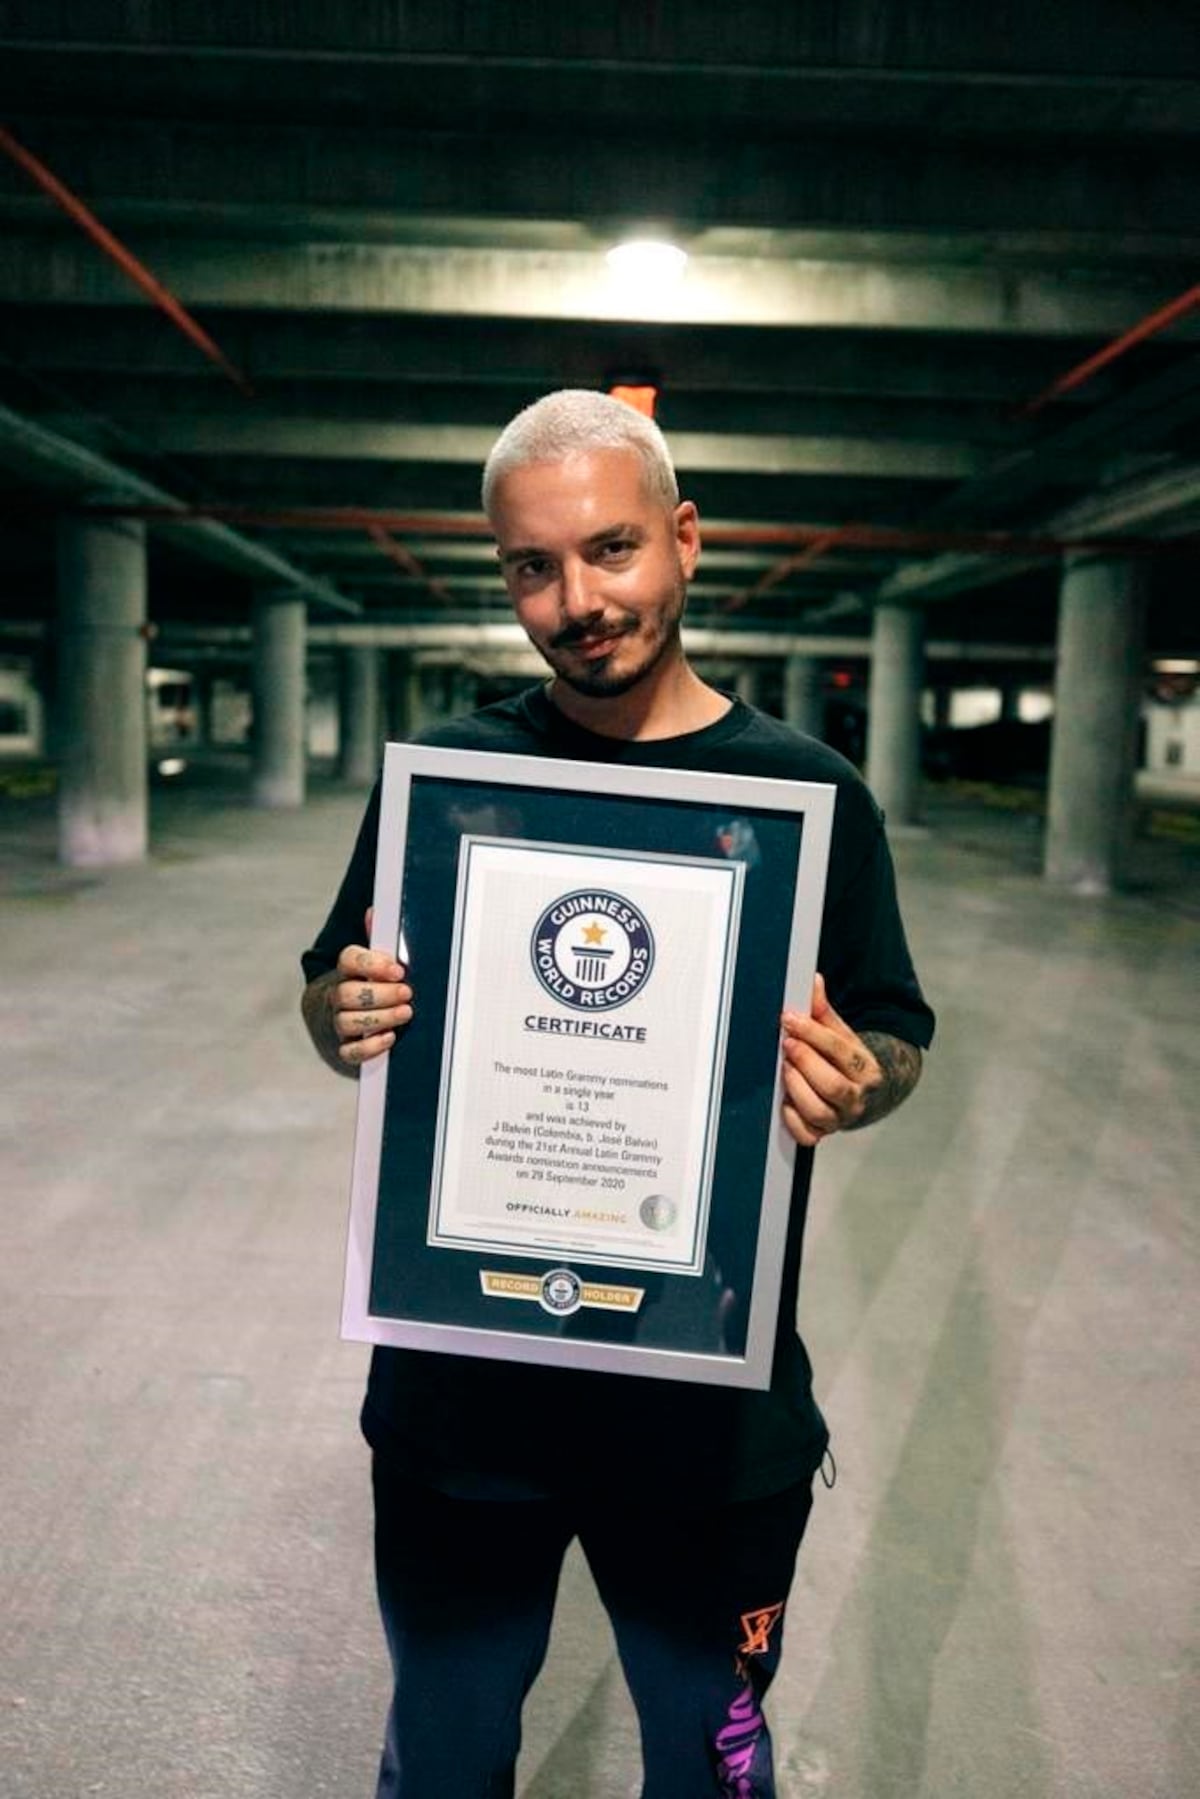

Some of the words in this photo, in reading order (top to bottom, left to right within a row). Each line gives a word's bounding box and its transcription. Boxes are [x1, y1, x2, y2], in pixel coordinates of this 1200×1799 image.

[551, 896, 641, 933] GUINNESS
[538, 938, 575, 998] WORLD
[580, 947, 648, 1005] RECORDS
[524, 1015, 647, 1041] CERTIFICATE
[494, 1061, 511, 1074] The
[513, 1066, 538, 1077] most
[540, 1067, 564, 1079] Latin
[566, 1069, 606, 1086] Grammy
[609, 1078, 669, 1091] nominations
[543, 1084, 552, 1093] in
[554, 1085, 560, 1094] a
[563, 1086, 591, 1098] single
[594, 1090, 614, 1100] year
[565, 1101, 574, 1110] is
[578, 1100, 590, 1112] 13
[492, 1120, 499, 1132] J
[502, 1121, 531, 1136] Balvin
[624, 1136, 658, 1150] Balvin)
[525, 1112, 544, 1122] and
[546, 1115, 566, 1125] was
[568, 1116, 612, 1130] achieved
[614, 1120, 627, 1133] by
[485, 1135, 515, 1150] during
[518, 1139, 533, 1150] the
[535, 1141, 557, 1153] 21st
[560, 1143, 593, 1157] Annual
[595, 1147, 619, 1159] Latin
[621, 1150, 663, 1167] Grammy
[487, 1150, 524, 1163] Awards
[526, 1156, 579, 1169] nomination
[582, 1162, 657, 1179] announcements
[516, 1170, 529, 1179] on
[531, 1169, 543, 1181] 29
[545, 1170, 598, 1187] September
[600, 1176, 625, 1190] 2020
[505, 1202, 570, 1217] OFFICIALLY
[573, 1207, 628, 1223] AMAZING
[490, 1277, 539, 1292] RECORD
[583, 1288, 632, 1304] HOLDER
